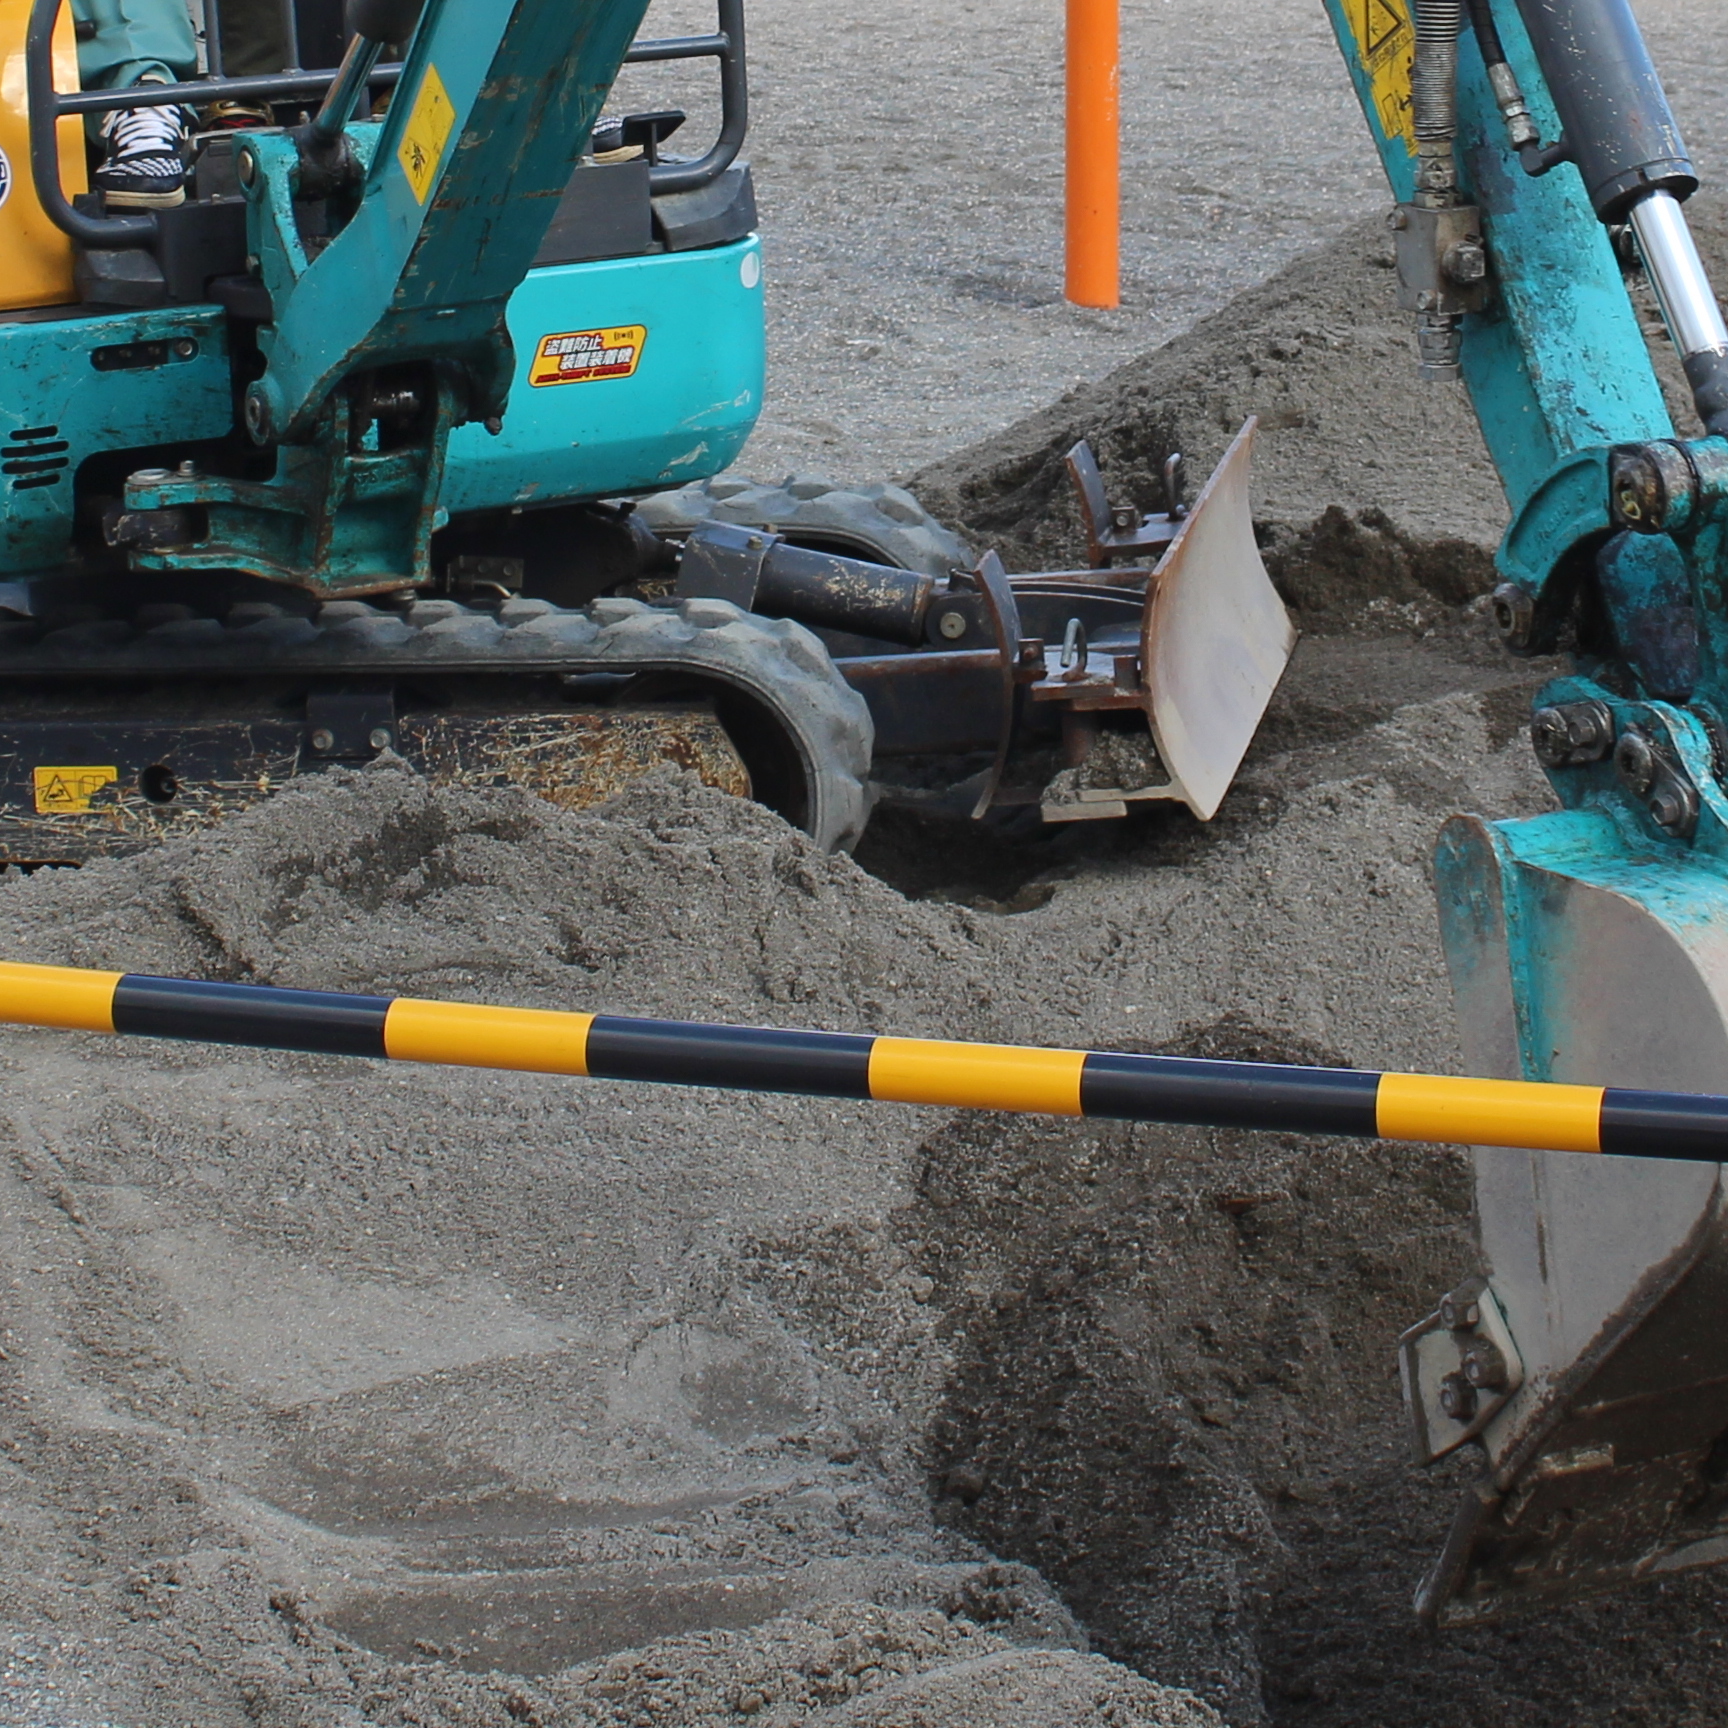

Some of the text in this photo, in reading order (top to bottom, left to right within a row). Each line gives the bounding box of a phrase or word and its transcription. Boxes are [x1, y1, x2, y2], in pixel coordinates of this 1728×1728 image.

[544, 334, 603, 356] 盗難防止
[560, 346, 633, 370] 装置装着機
